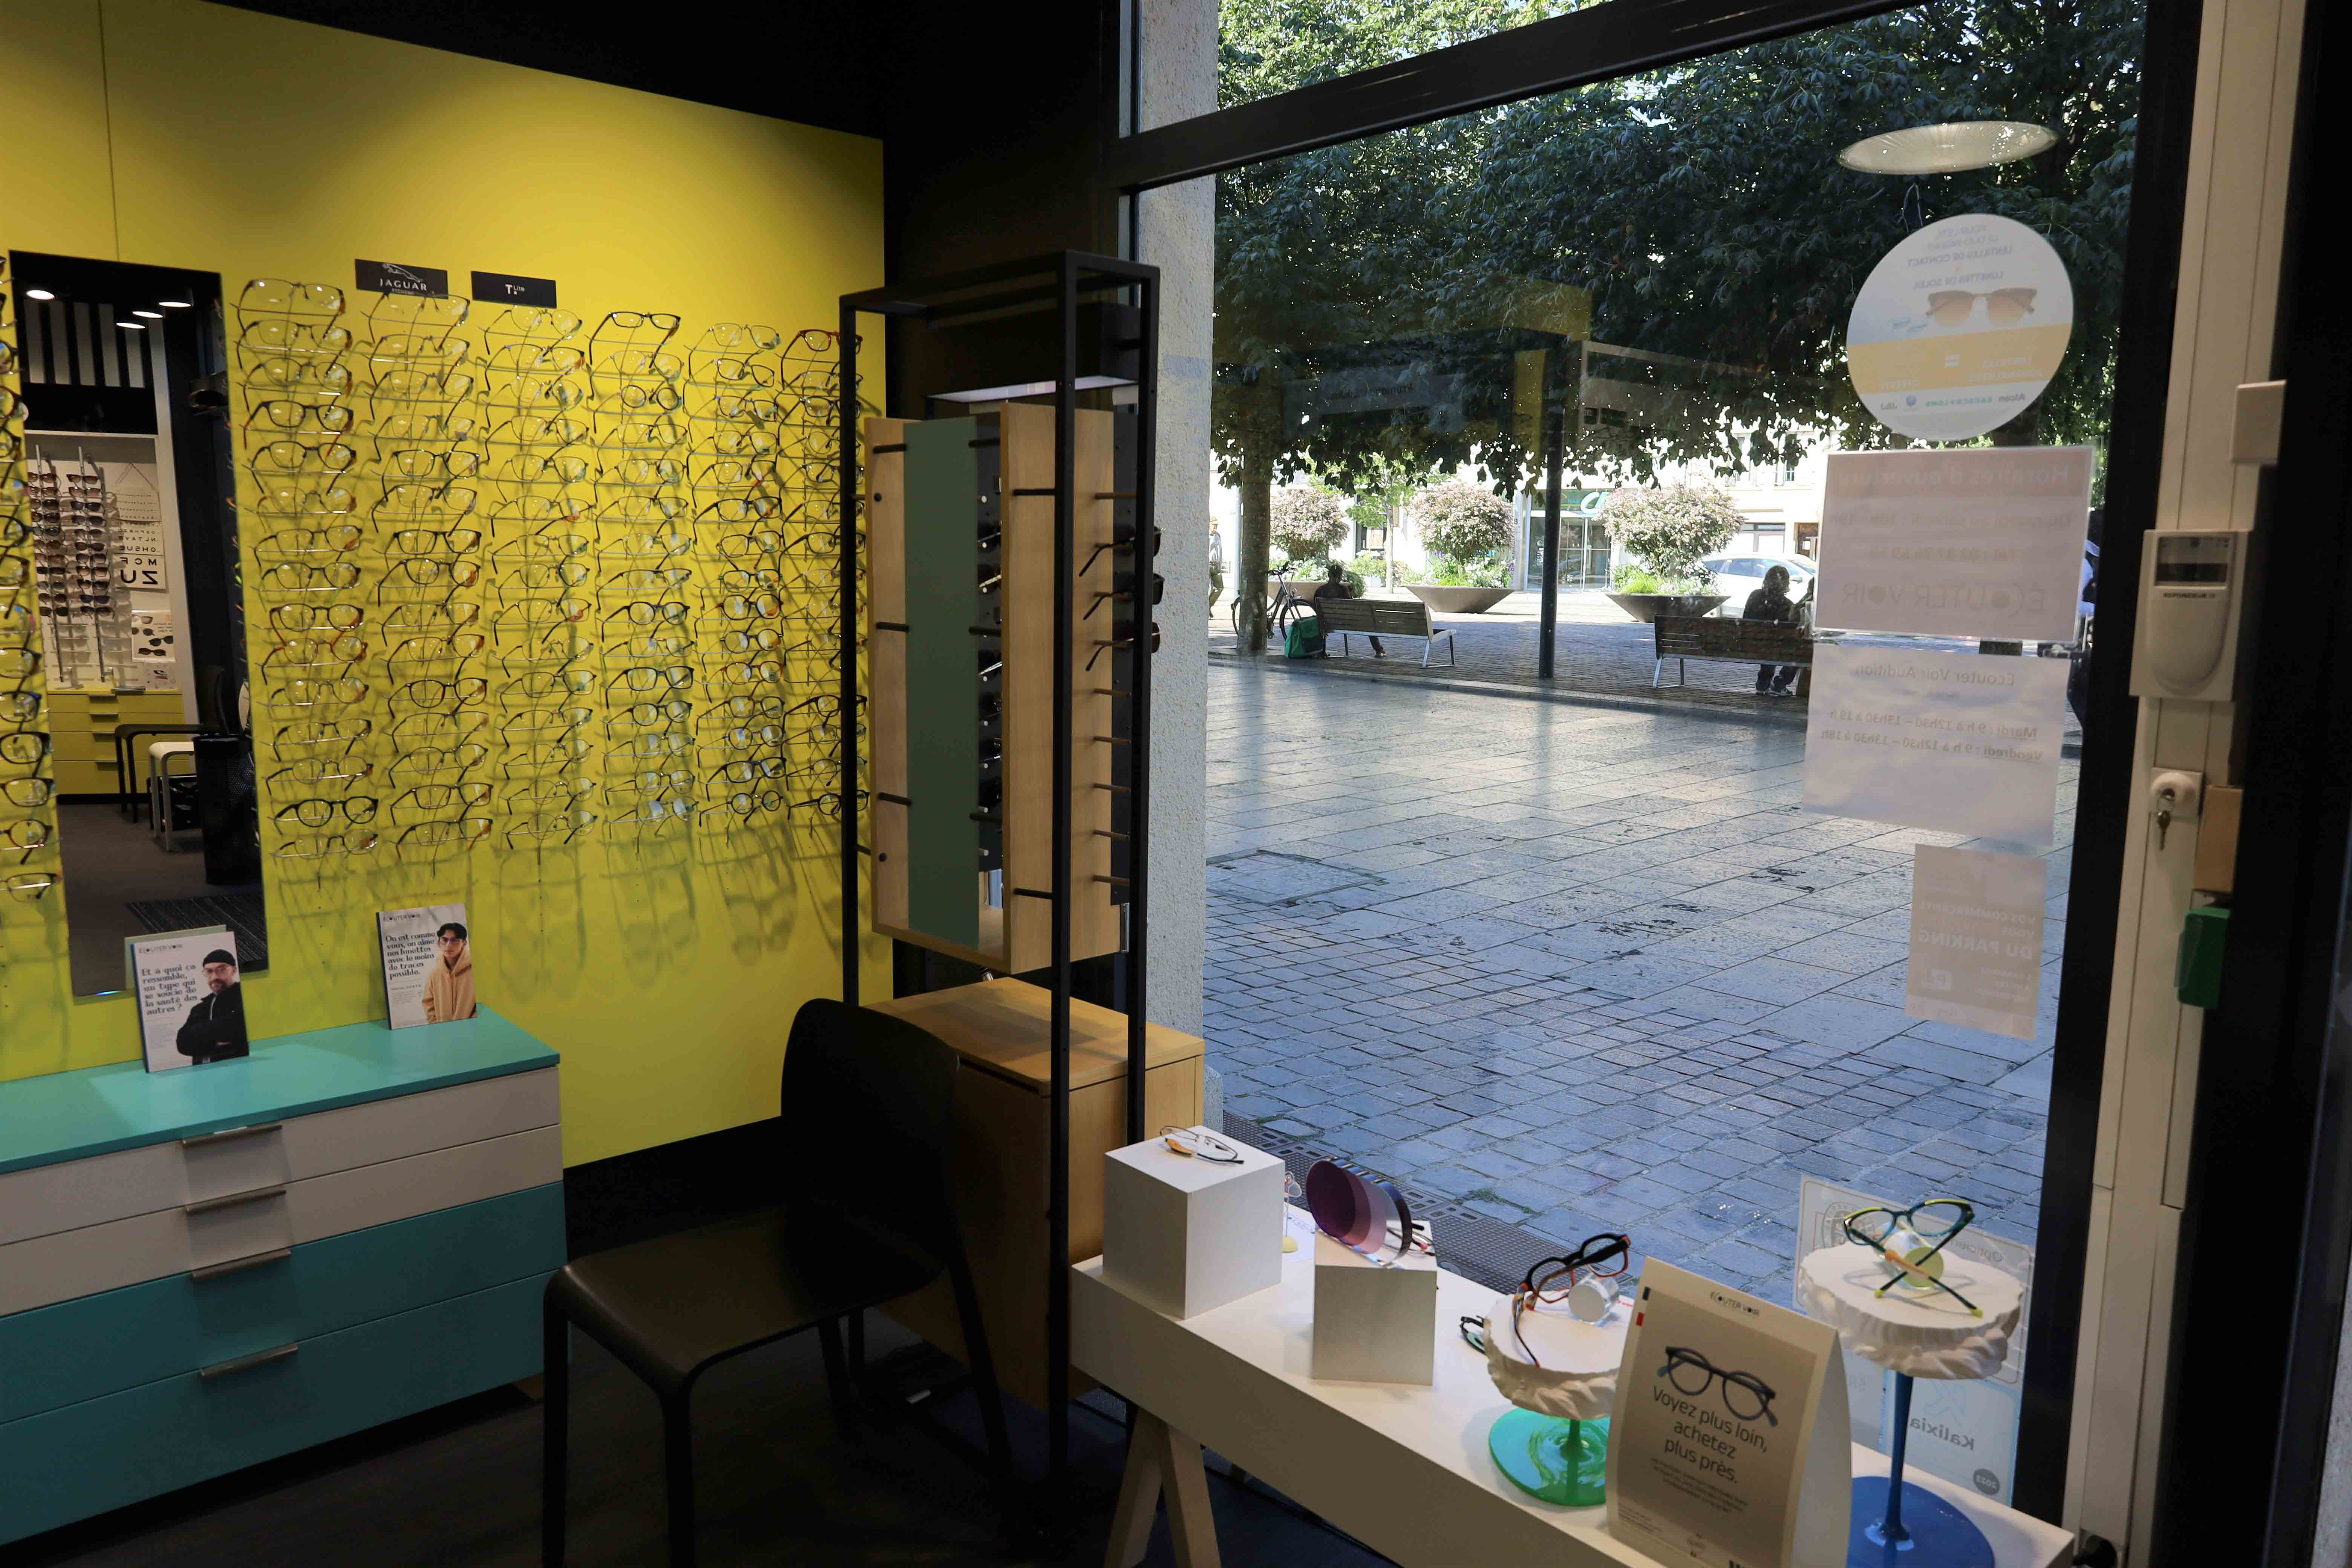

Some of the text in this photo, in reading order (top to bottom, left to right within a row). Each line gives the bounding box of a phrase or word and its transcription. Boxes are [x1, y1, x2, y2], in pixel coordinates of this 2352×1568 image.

[380, 278, 428, 291] JAGUAR
[400, 946, 431, 956] lunettes
[164, 964, 182, 975] quoi
[401, 961, 424, 970] traces
[143, 973, 188, 984] ressemble,
[389, 968, 420, 980] possible.
[159, 982, 179, 992] type
[183, 979, 196, 988] qui
[157, 989, 182, 998] soucie
[157, 996, 181, 1006] santé
[147, 1006, 175, 1015] autres
[1654, 1385, 1767, 1453] Voyez plus loin,
[1674, 1421, 1737, 1459] achetez
[1664, 1439, 1737, 1484] plus près.
